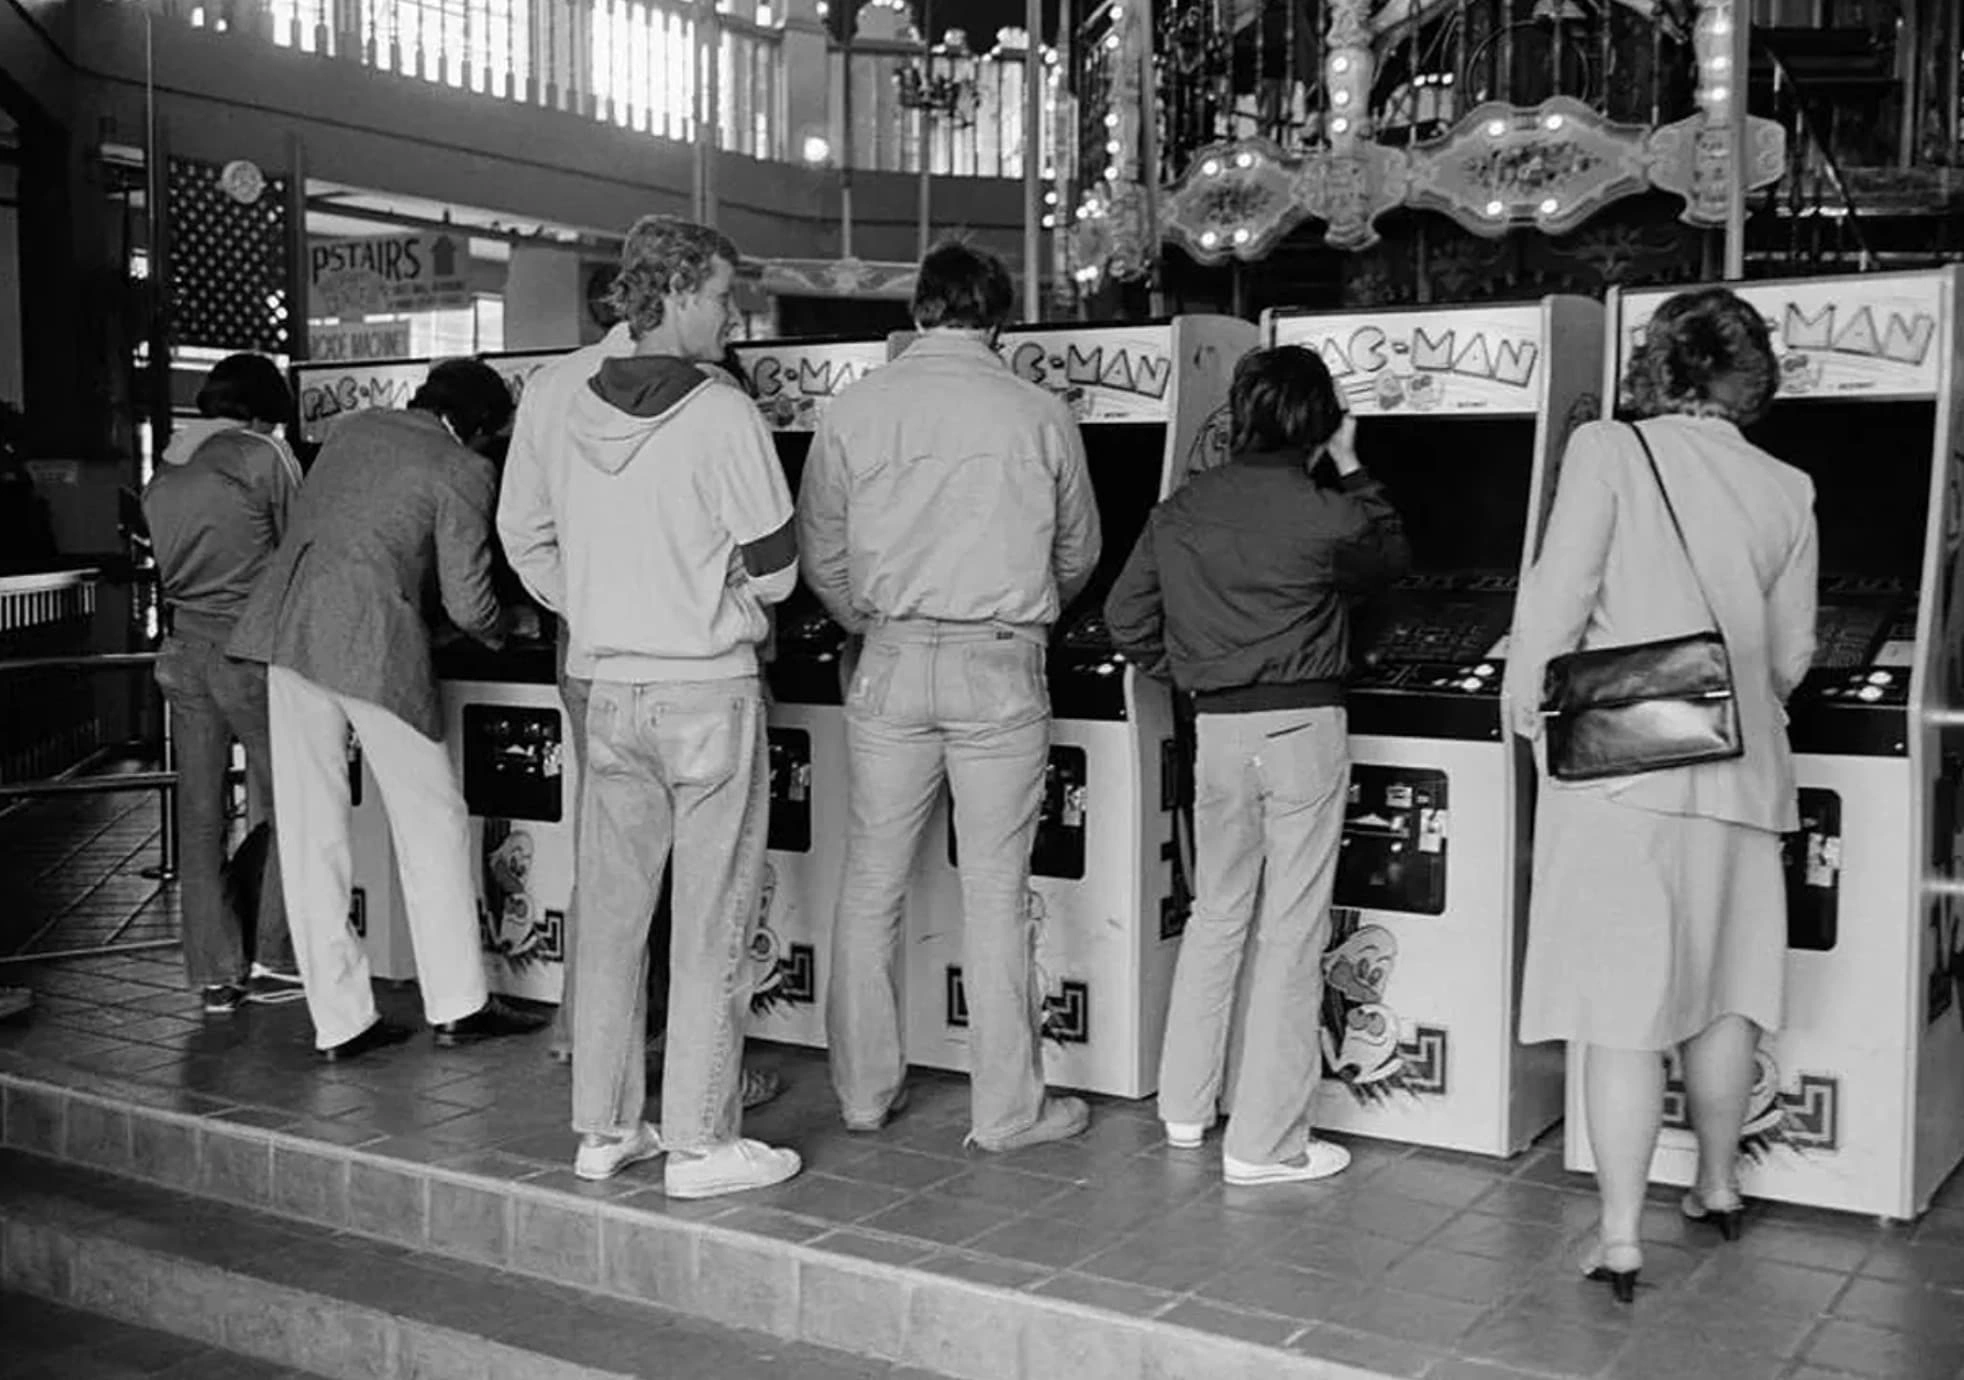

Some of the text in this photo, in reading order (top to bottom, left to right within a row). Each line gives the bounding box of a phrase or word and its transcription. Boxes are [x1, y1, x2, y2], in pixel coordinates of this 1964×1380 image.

[313, 238, 421, 285] PSTAIRS
[1012, 341, 1172, 400] C-MAN
[1302, 325, 1538, 388] AC-MAN
[302, 376, 411, 422] PAC-MA
